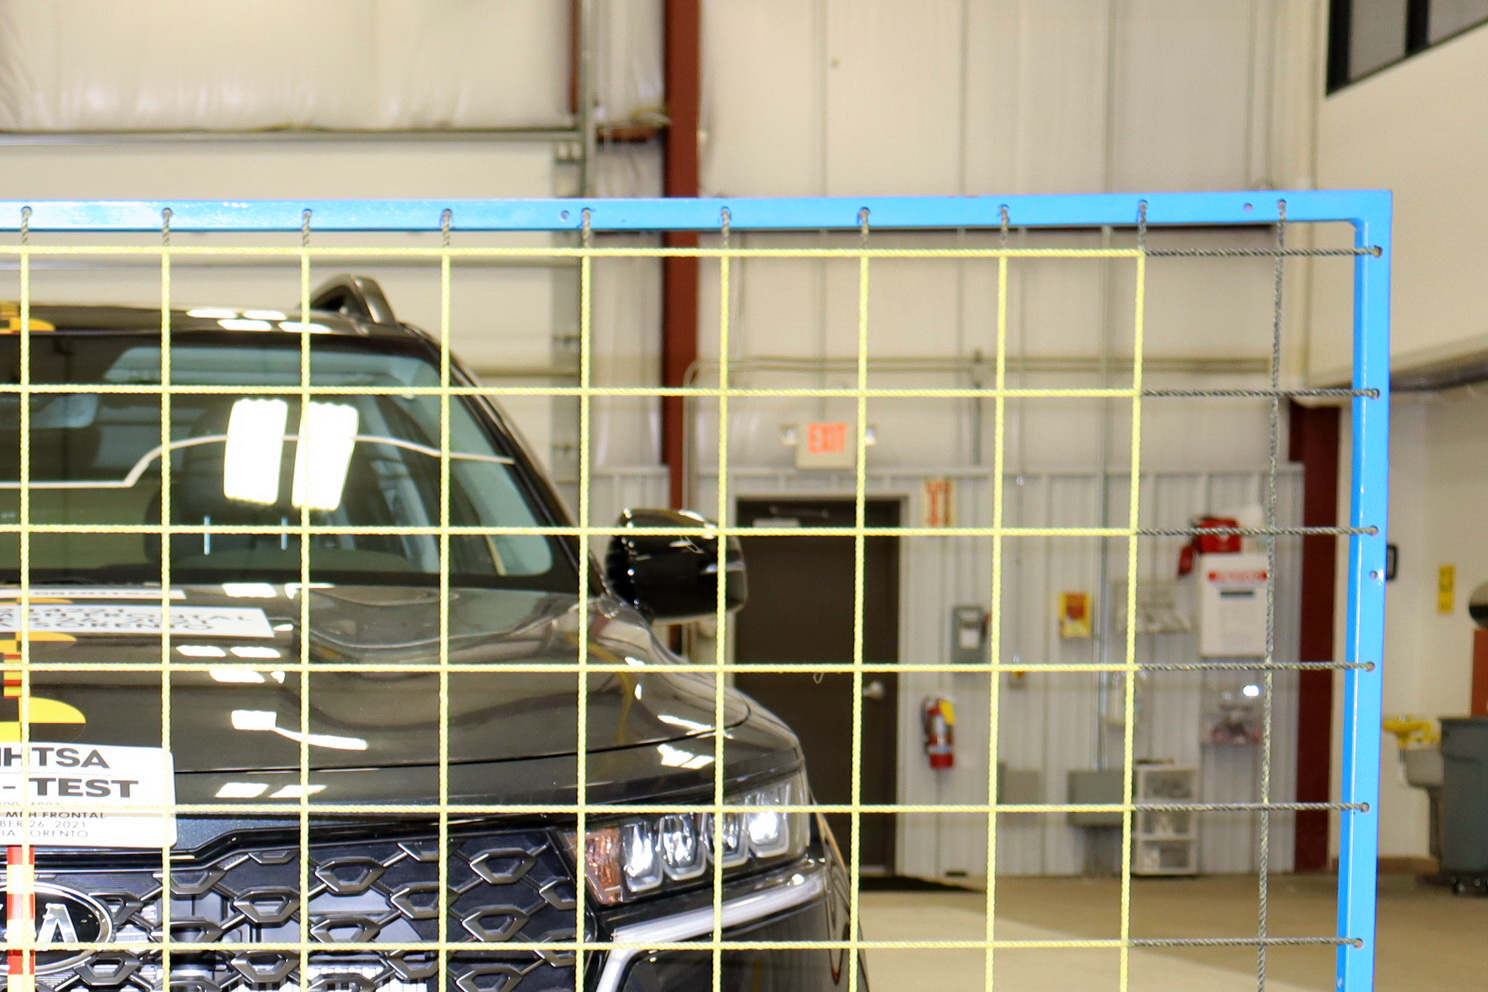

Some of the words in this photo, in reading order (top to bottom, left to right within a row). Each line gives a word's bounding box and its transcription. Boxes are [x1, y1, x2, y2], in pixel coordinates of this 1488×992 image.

[28, 777, 139, 799] TEST
[42, 811, 107, 819] FRONTAL
[55, 820, 87, 829] 2021
